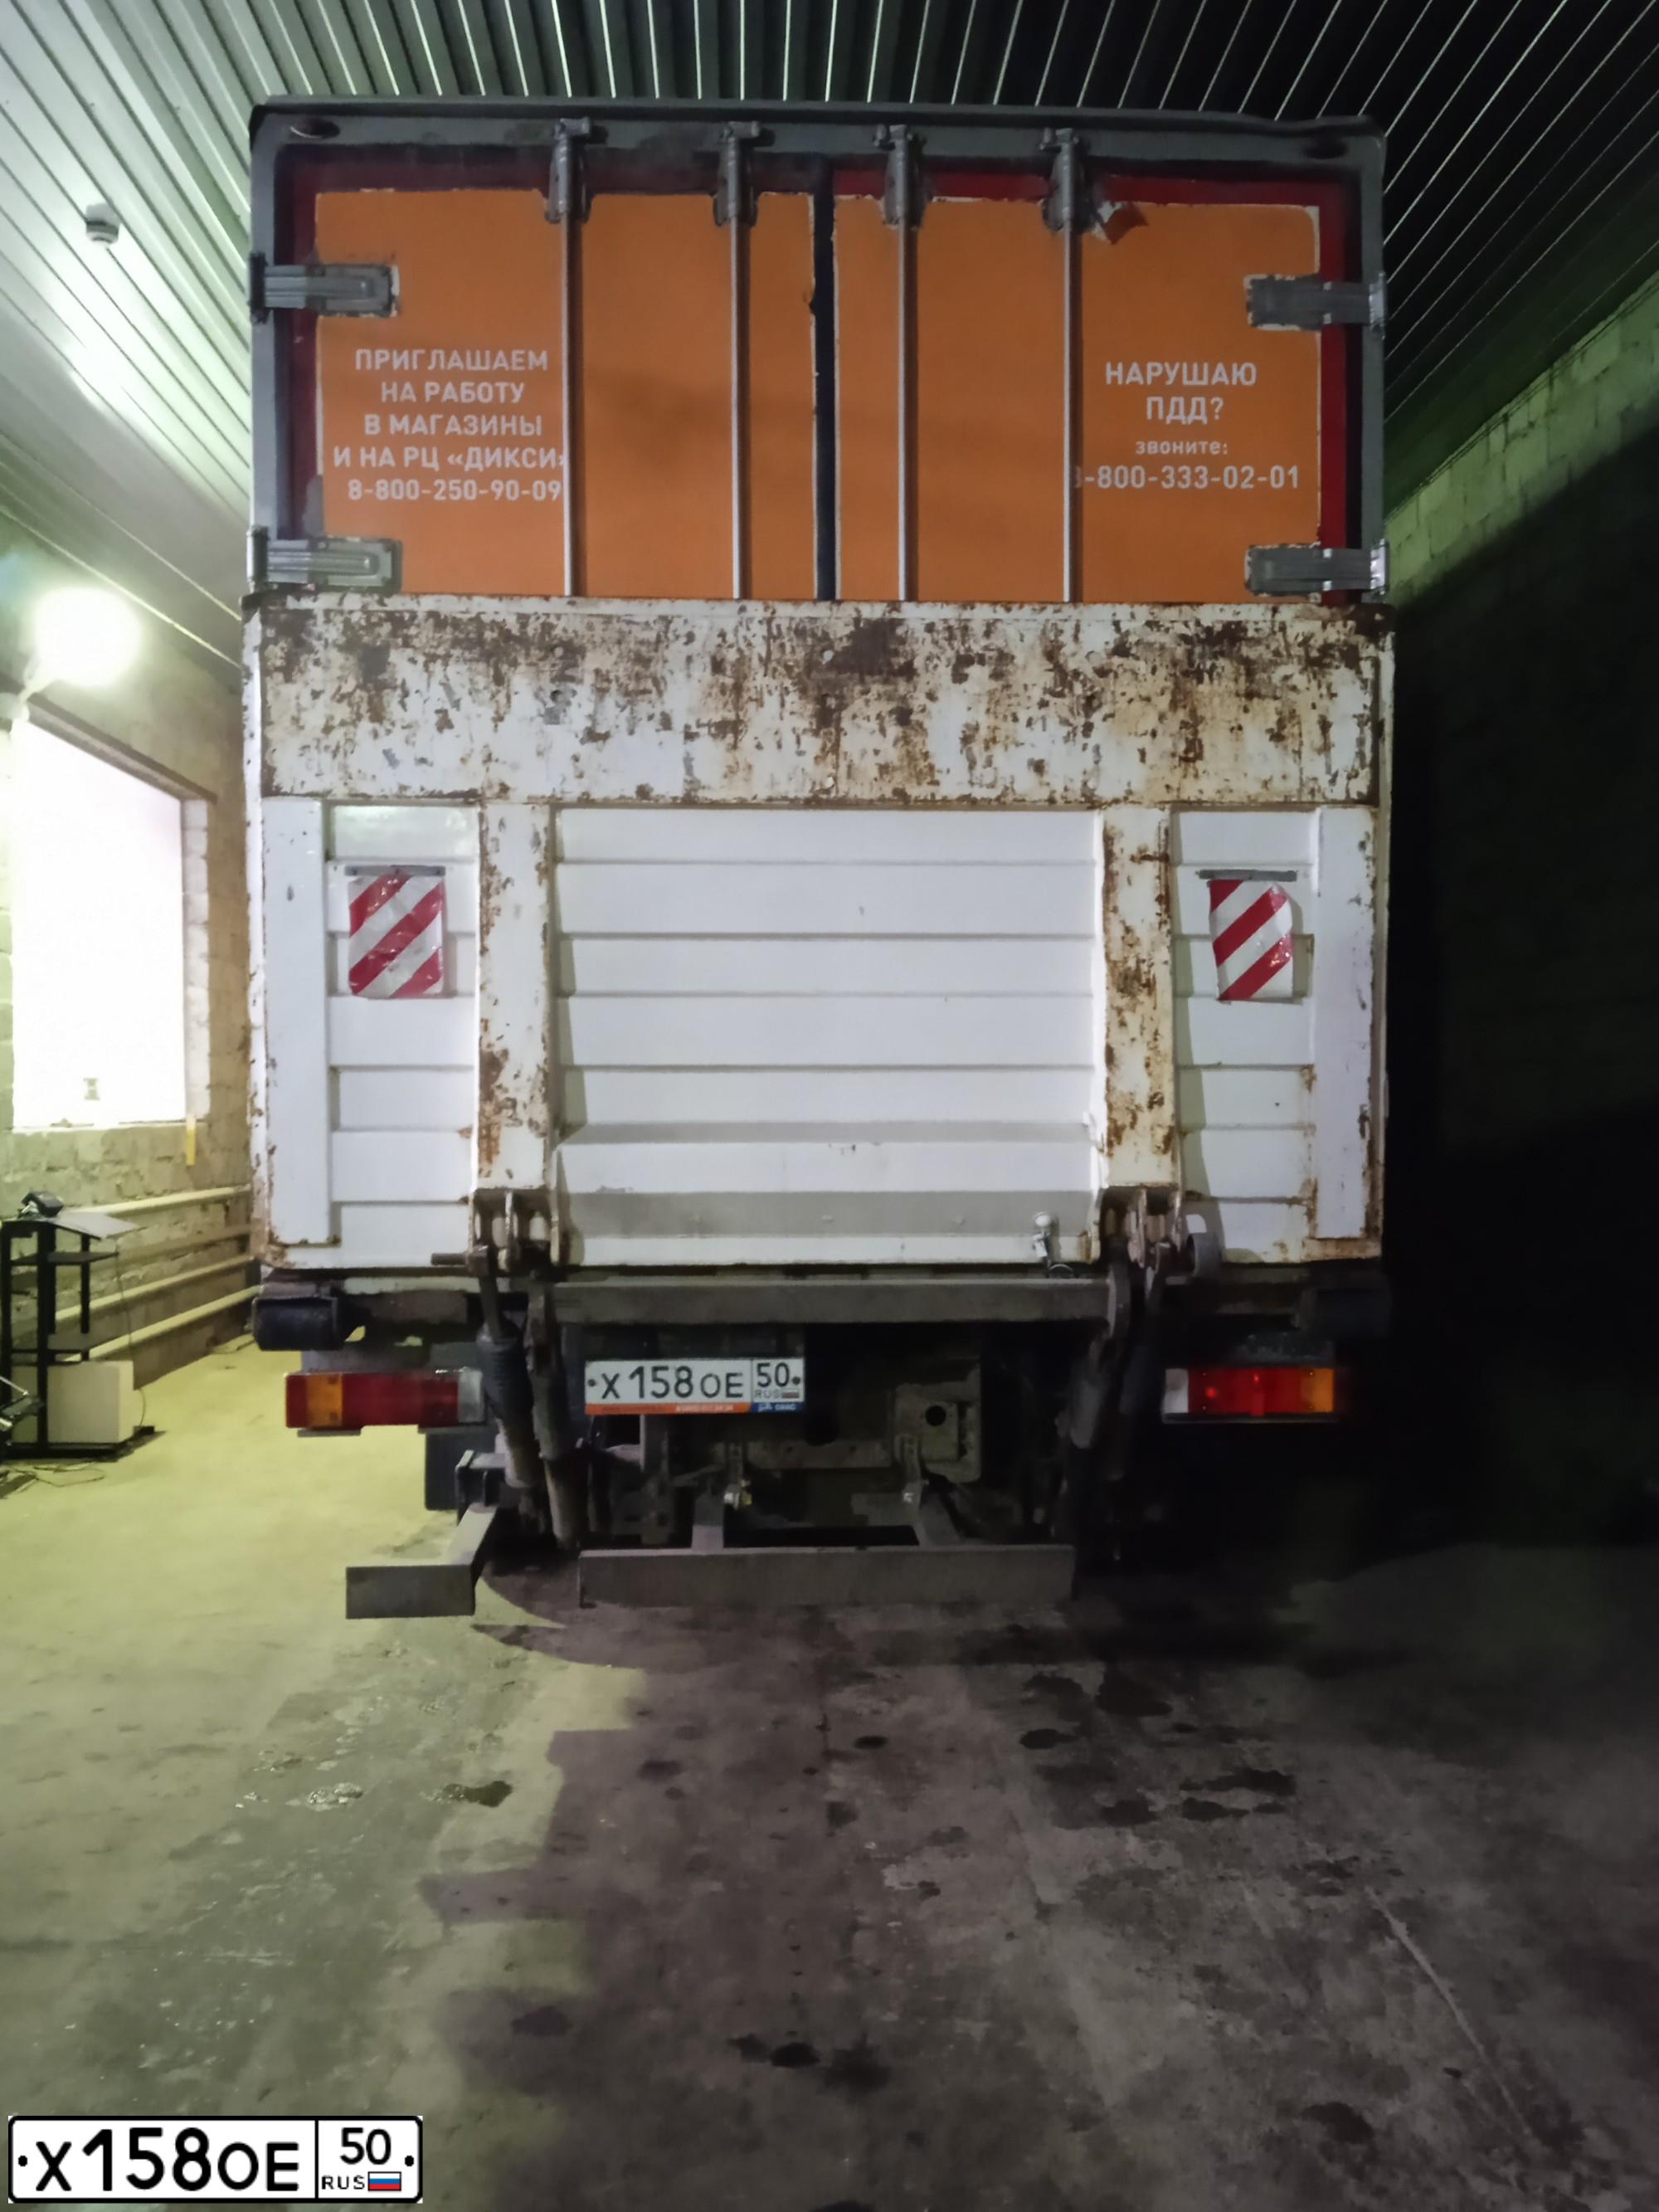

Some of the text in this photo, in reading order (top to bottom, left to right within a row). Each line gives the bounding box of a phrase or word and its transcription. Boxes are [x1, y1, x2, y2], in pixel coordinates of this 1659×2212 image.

[355, 348, 547, 371] ПРИГЛАШАЕМ
[1105, 362, 1257, 386] НАРУШАЮ
[381, 382, 524, 403] НА РАБОТУ
[1146, 397, 1224, 425] ПДД?
[364, 414, 542, 436] В МАГАЗИНЫ
[333, 447, 350, 467] И
[359, 446, 395, 467] НА
[404, 446, 440, 470] РЦ
[1135, 440, 1228, 455] звоните:
[348, 479, 561, 501] 8-800-250-90-09
[756, 1362, 790, 1388] 50
[754, 1389, 781, 1399] RUS
